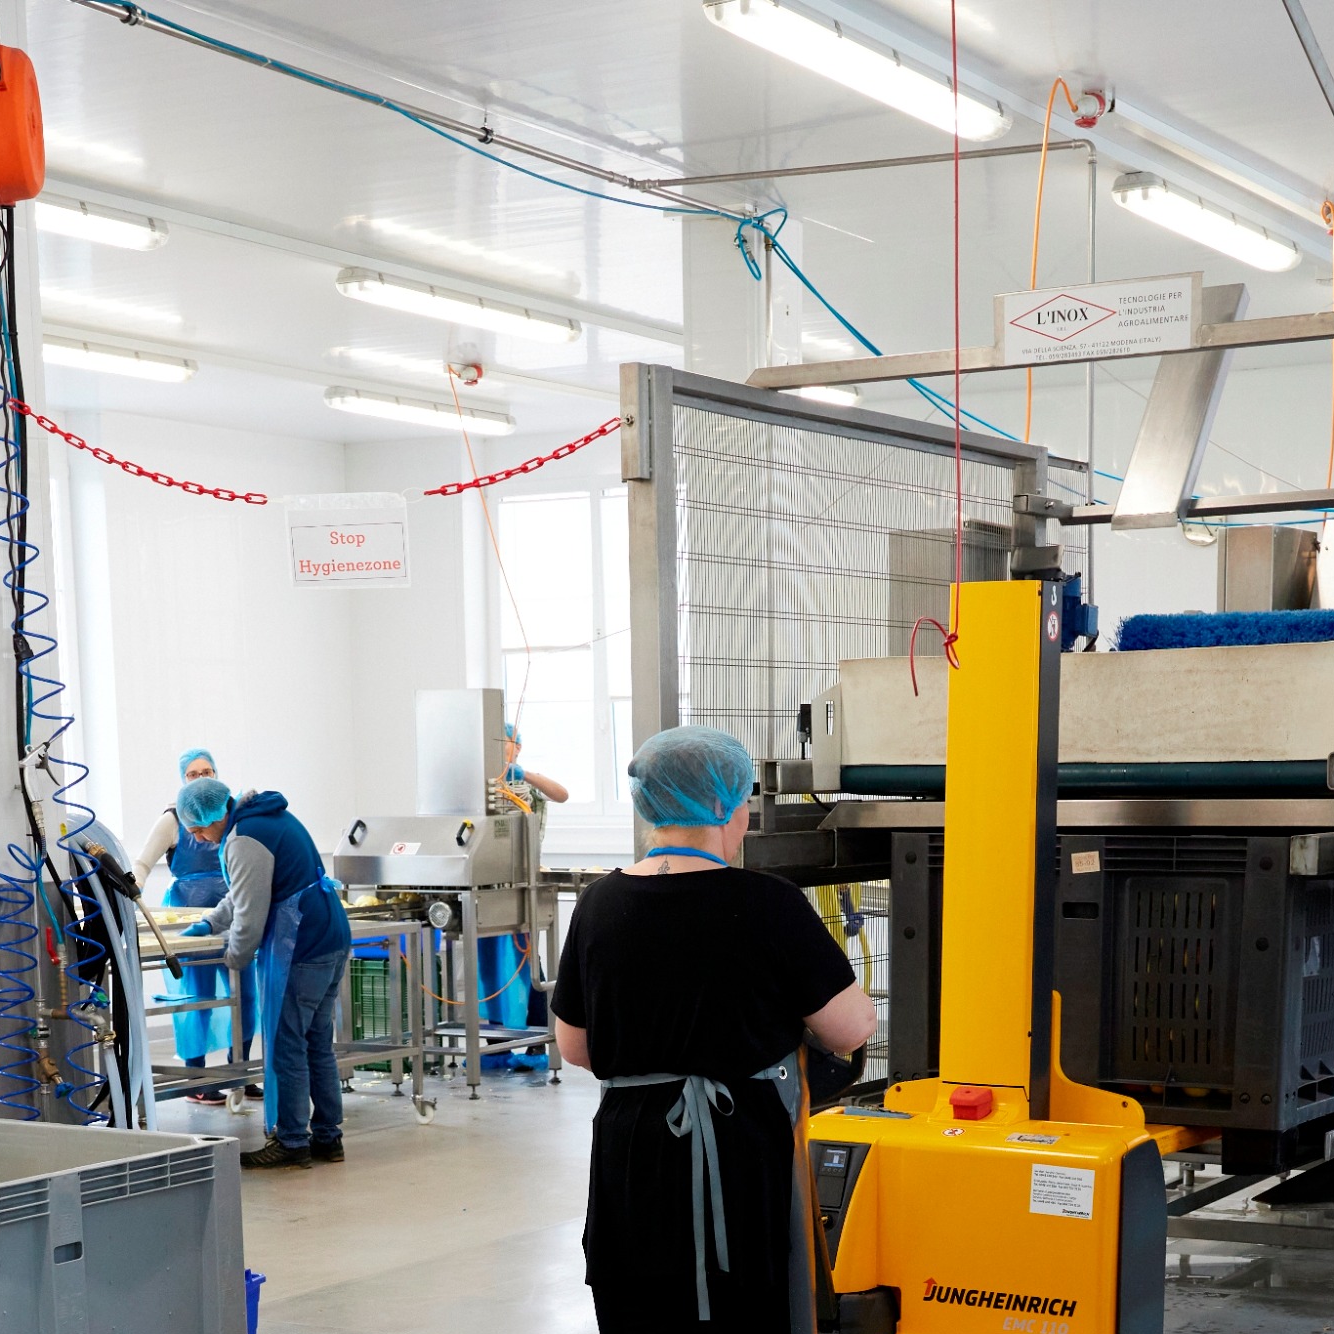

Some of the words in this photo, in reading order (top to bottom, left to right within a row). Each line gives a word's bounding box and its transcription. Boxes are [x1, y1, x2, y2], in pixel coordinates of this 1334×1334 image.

[1118, 293, 1166, 304] TECNOLOGIE
[1168, 291, 1183, 300] PER
[1036, 307, 1088, 325] L'INOX
[1118, 305, 1166, 316] L'INDUSTRIA
[1118, 314, 1189, 328] AGROALIMENTARE
[329, 531, 365, 547] Stop
[299, 559, 401, 576] Hygienezone
[923, 1285, 1078, 1317] JUNGHEINRICH
[1002, 1316, 1037, 1333] EMC
